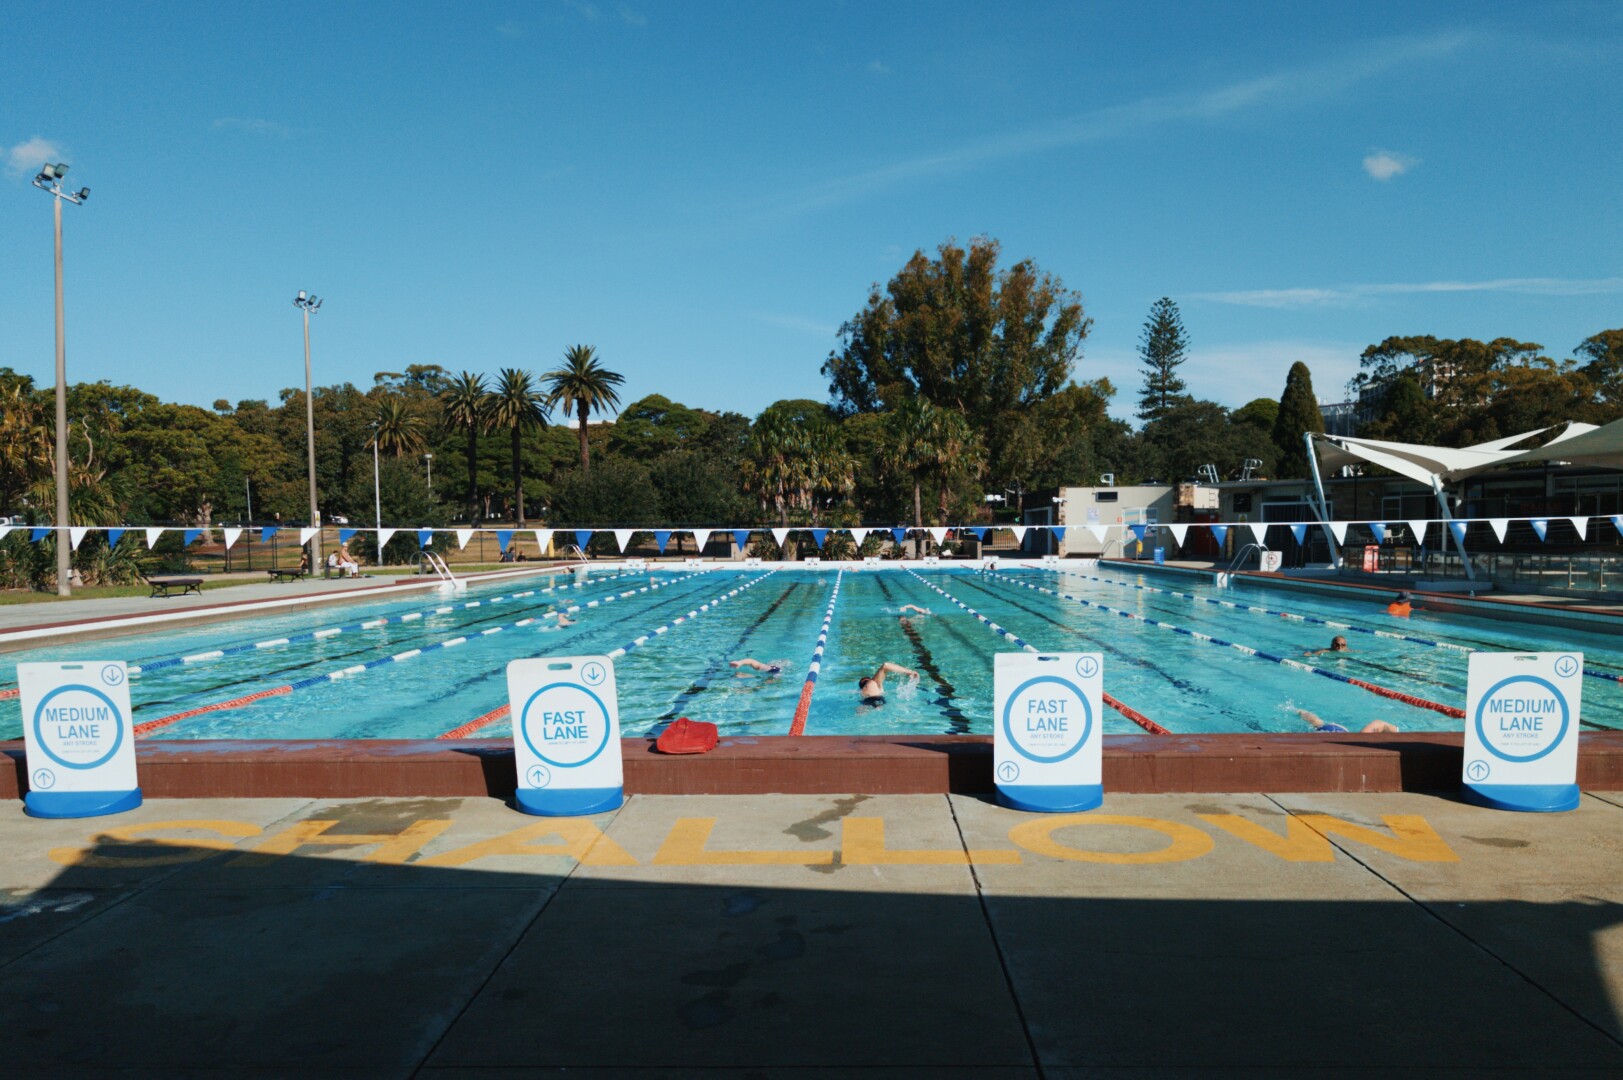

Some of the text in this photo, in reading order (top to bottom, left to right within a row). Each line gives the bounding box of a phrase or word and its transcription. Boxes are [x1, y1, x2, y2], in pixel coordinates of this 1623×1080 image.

[1028, 700, 1067, 713] FAST
[1489, 699, 1556, 713] MEDIUM
[45, 707, 108, 722] MEDIUM
[543, 711, 585, 725] FAST
[1027, 717, 1068, 731] LANE
[1500, 717, 1543, 731] LANE
[58, 724, 100, 739] LANE
[543, 726, 588, 740] LANE
[48, 814, 1461, 866] SHALLOW
